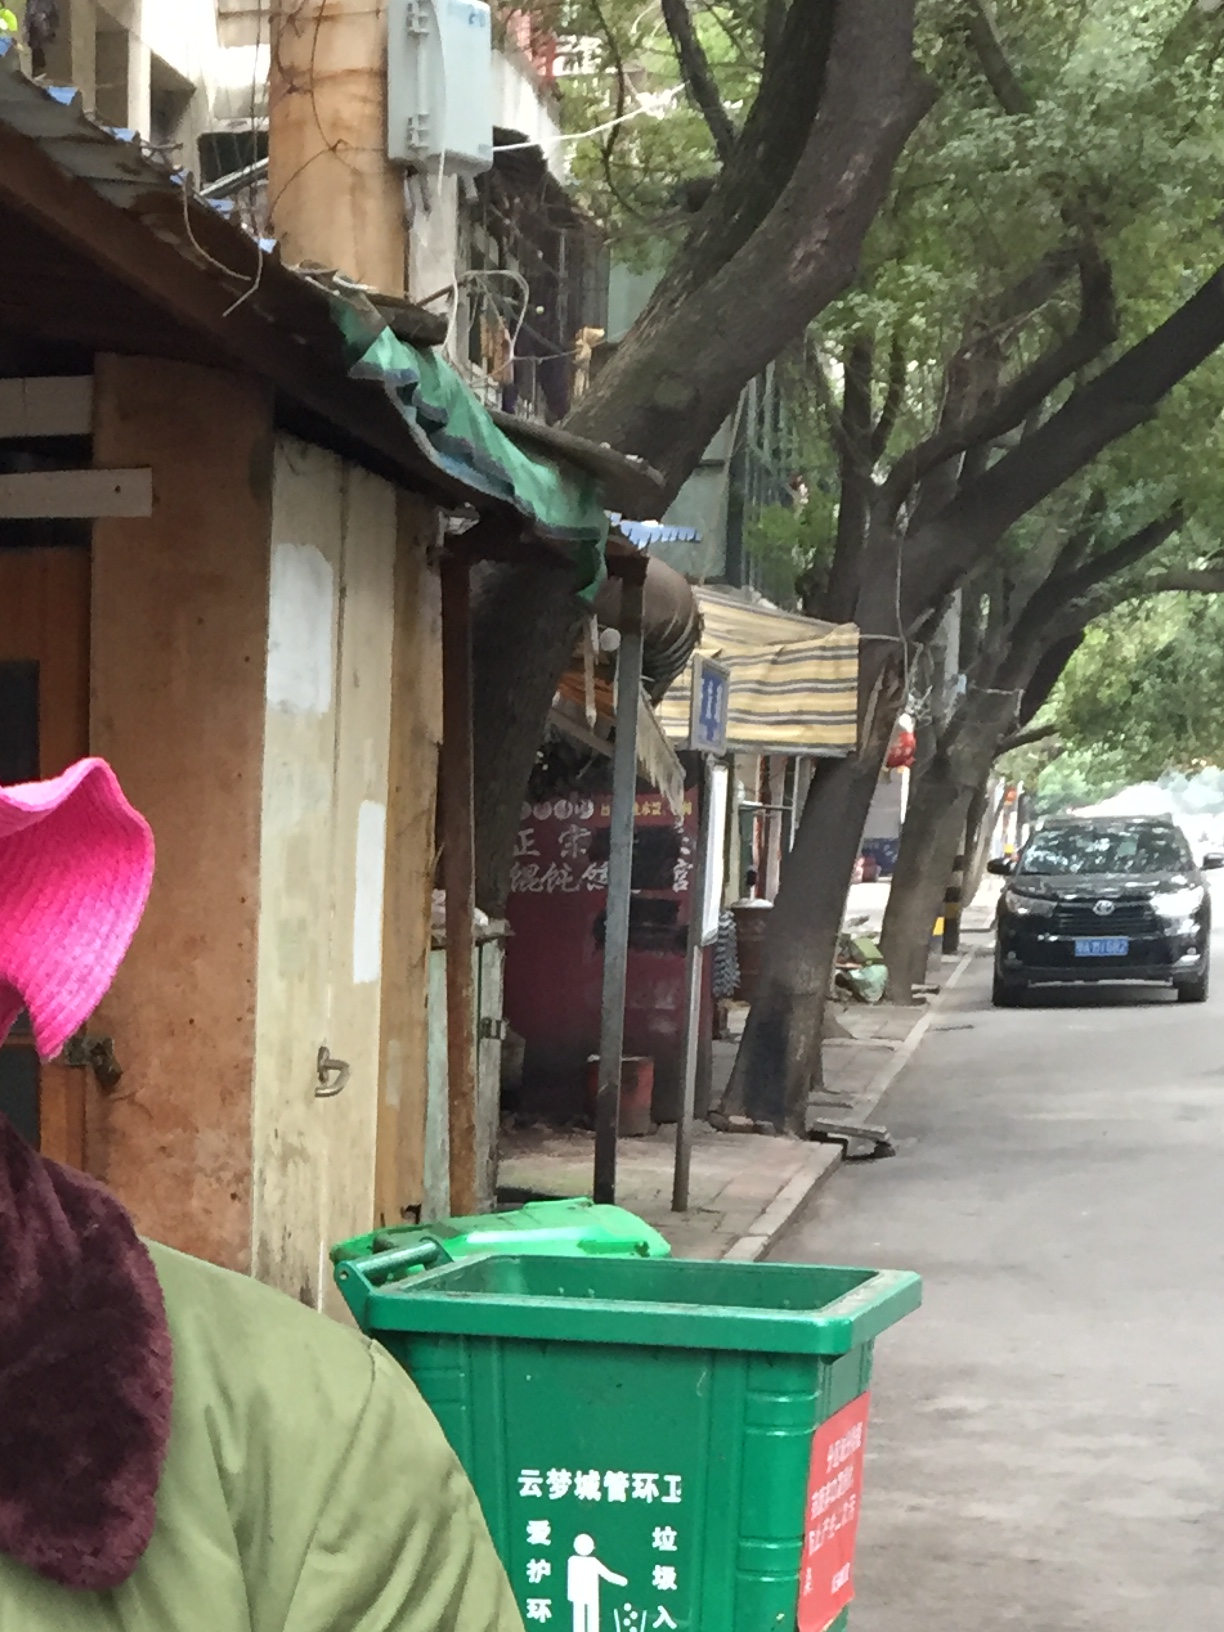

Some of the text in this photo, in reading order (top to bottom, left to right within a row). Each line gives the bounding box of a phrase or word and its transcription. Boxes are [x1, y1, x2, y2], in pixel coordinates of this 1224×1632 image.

[518, 1467, 682, 1503] 云梦城管环卫
